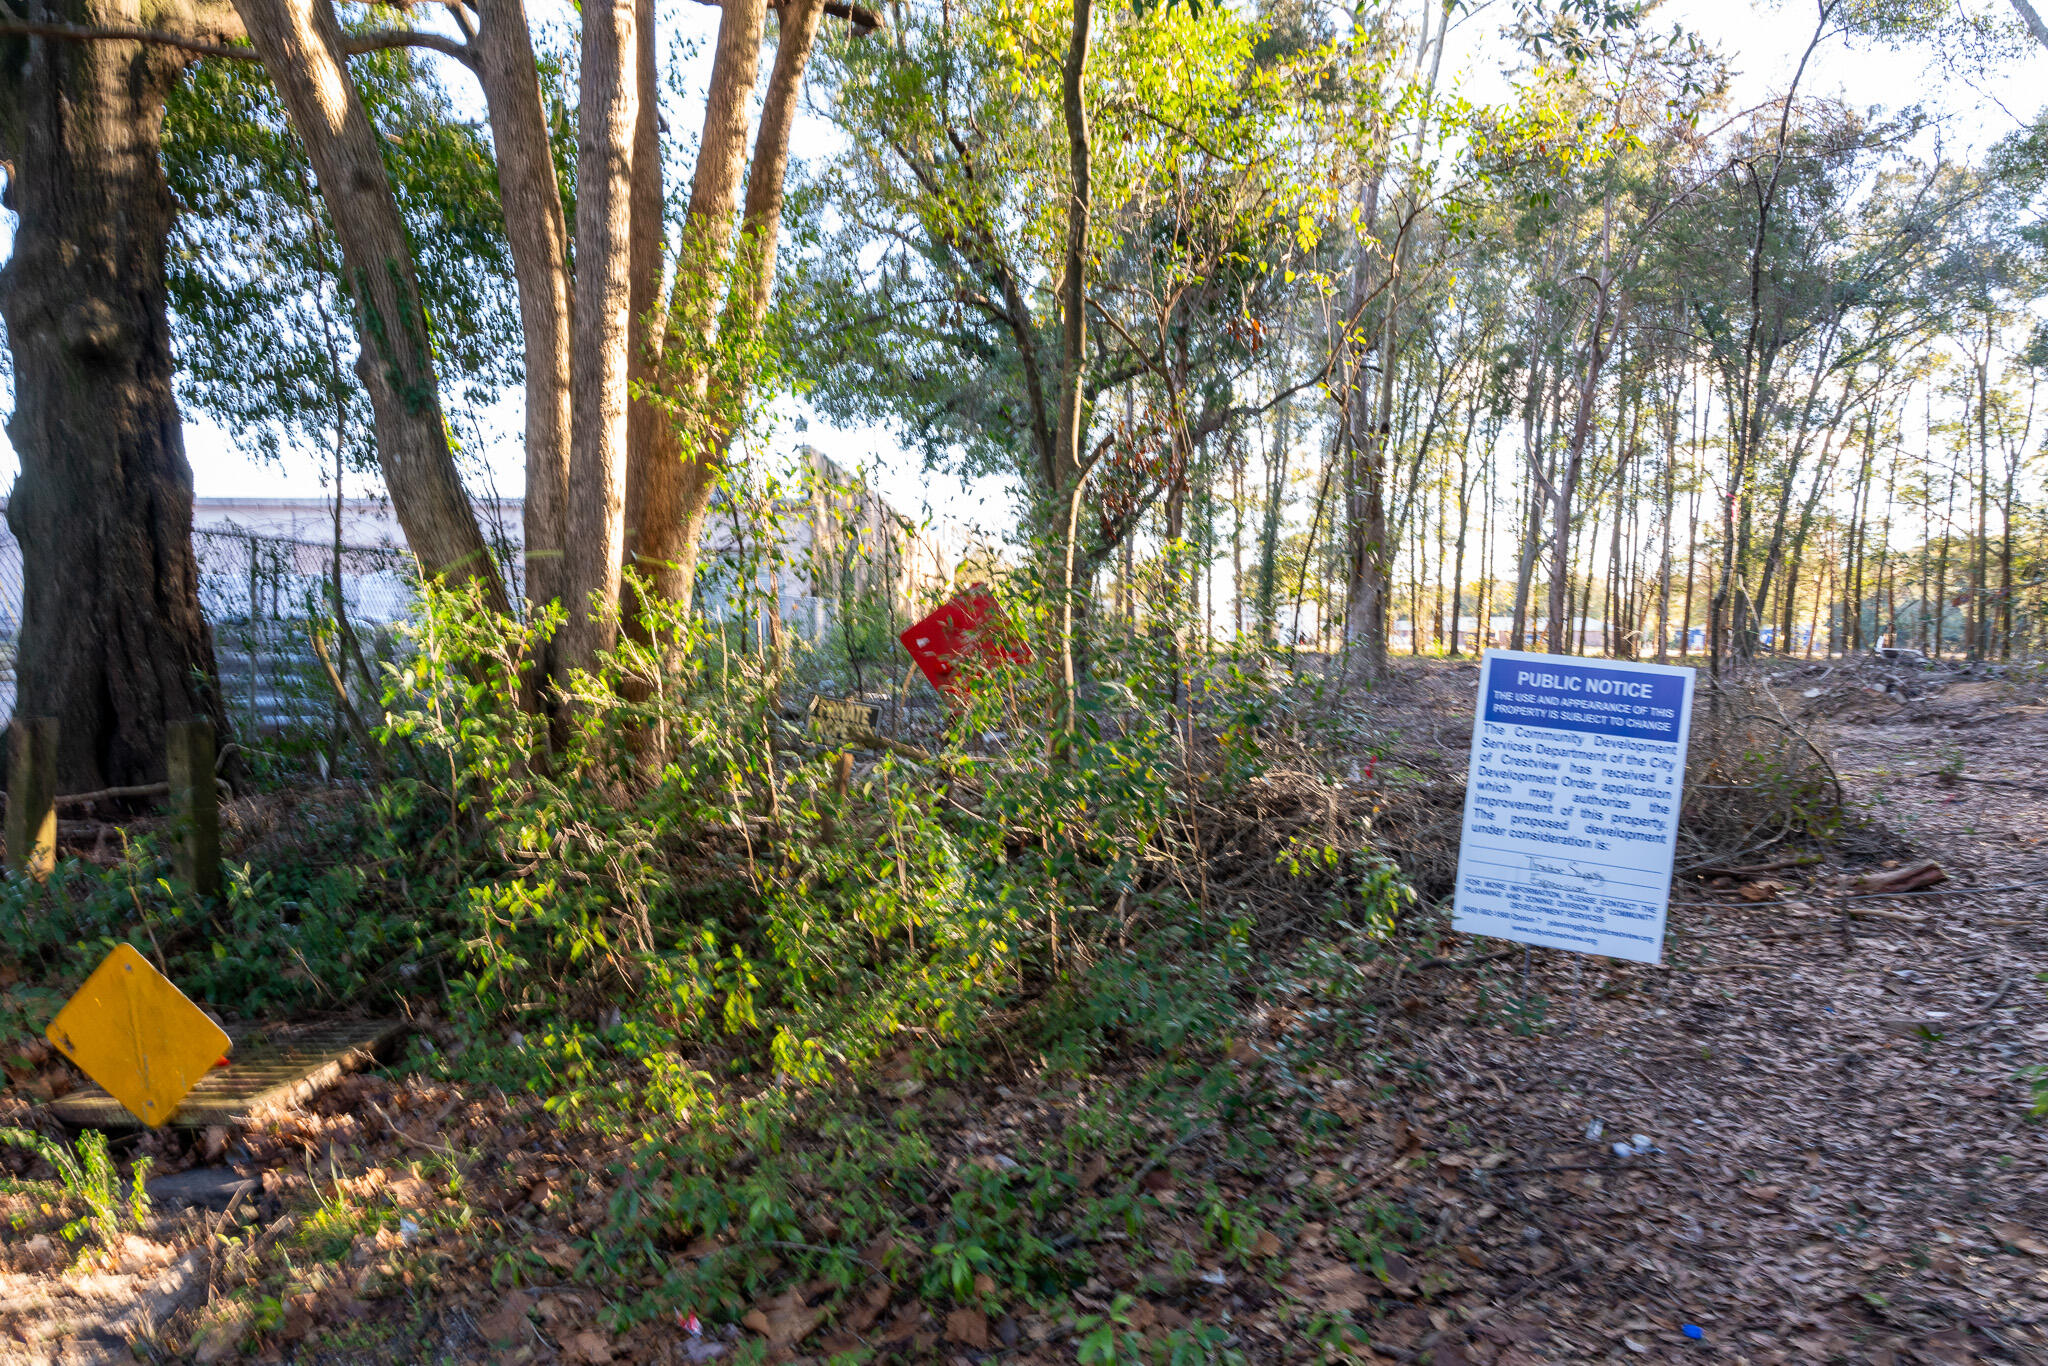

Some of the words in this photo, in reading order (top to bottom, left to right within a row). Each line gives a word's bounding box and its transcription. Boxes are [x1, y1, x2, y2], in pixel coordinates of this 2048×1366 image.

[1518, 671, 1581, 690] PUBLIC
[1585, 678, 1653, 698] NOTICE
[1493, 690, 1513, 701] THE
[1515, 693, 1535, 704] USE
[1537, 695, 1559, 706] AND
[1561, 698, 1630, 712] APPEARANCE
[1633, 704, 1647, 715] OF
[1650, 707, 1674, 718] THIS
[1493, 704, 1545, 717] PROPERTY
[1548, 709, 1559, 719] IS
[1560, 711, 1605, 724] SUBJECT
[1608, 715, 1623, 726] TO
[1626, 718, 1671, 731] CHANGE
[1481, 738, 1531, 752] Services
[1535, 744, 1607, 762] Department
[1611, 752, 1623, 763] of
[1626, 755, 1646, 766] the
[1650, 757, 1674, 771] City
[1483, 724, 1504, 735] The
[1514, 727, 1583, 745] Community
[1594, 736, 1676, 755] Development
[1478, 766, 1557, 786] Development
[1561, 776, 1595, 789] Order
[1601, 781, 1671, 800] application
[1479, 751, 1492, 762] of
[1501, 754, 1560, 770] Crestview
[1570, 763, 1591, 774] has
[1602, 767, 1655, 781] received
[1665, 775, 1673, 784] a
[1474, 795, 1553, 814] improvement
[1560, 806, 1573, 816] of
[1580, 809, 1603, 820] this
[1611, 814, 1667, 830] property.
[1476, 781, 1511, 794] which
[1529, 789, 1554, 801] may
[1572, 794, 1630, 808] authorize
[1649, 803, 1669, 814] the
[1471, 823, 1505, 836] under
[1509, 828, 1591, 847] consideration
[1594, 840, 1610, 851] is:
[1473, 809, 1495, 820] The
[1510, 814, 1569, 831] proposed
[1584, 824, 1666, 845] development
[1510, 902, 1564, 915] DEVELOPMENT
[1567, 911, 1604, 923] SERVICES
[1567, 893, 1595, 904] PLEASE
[1600, 899, 1636, 910] CONTACT
[1641, 904, 1656, 913] THE
